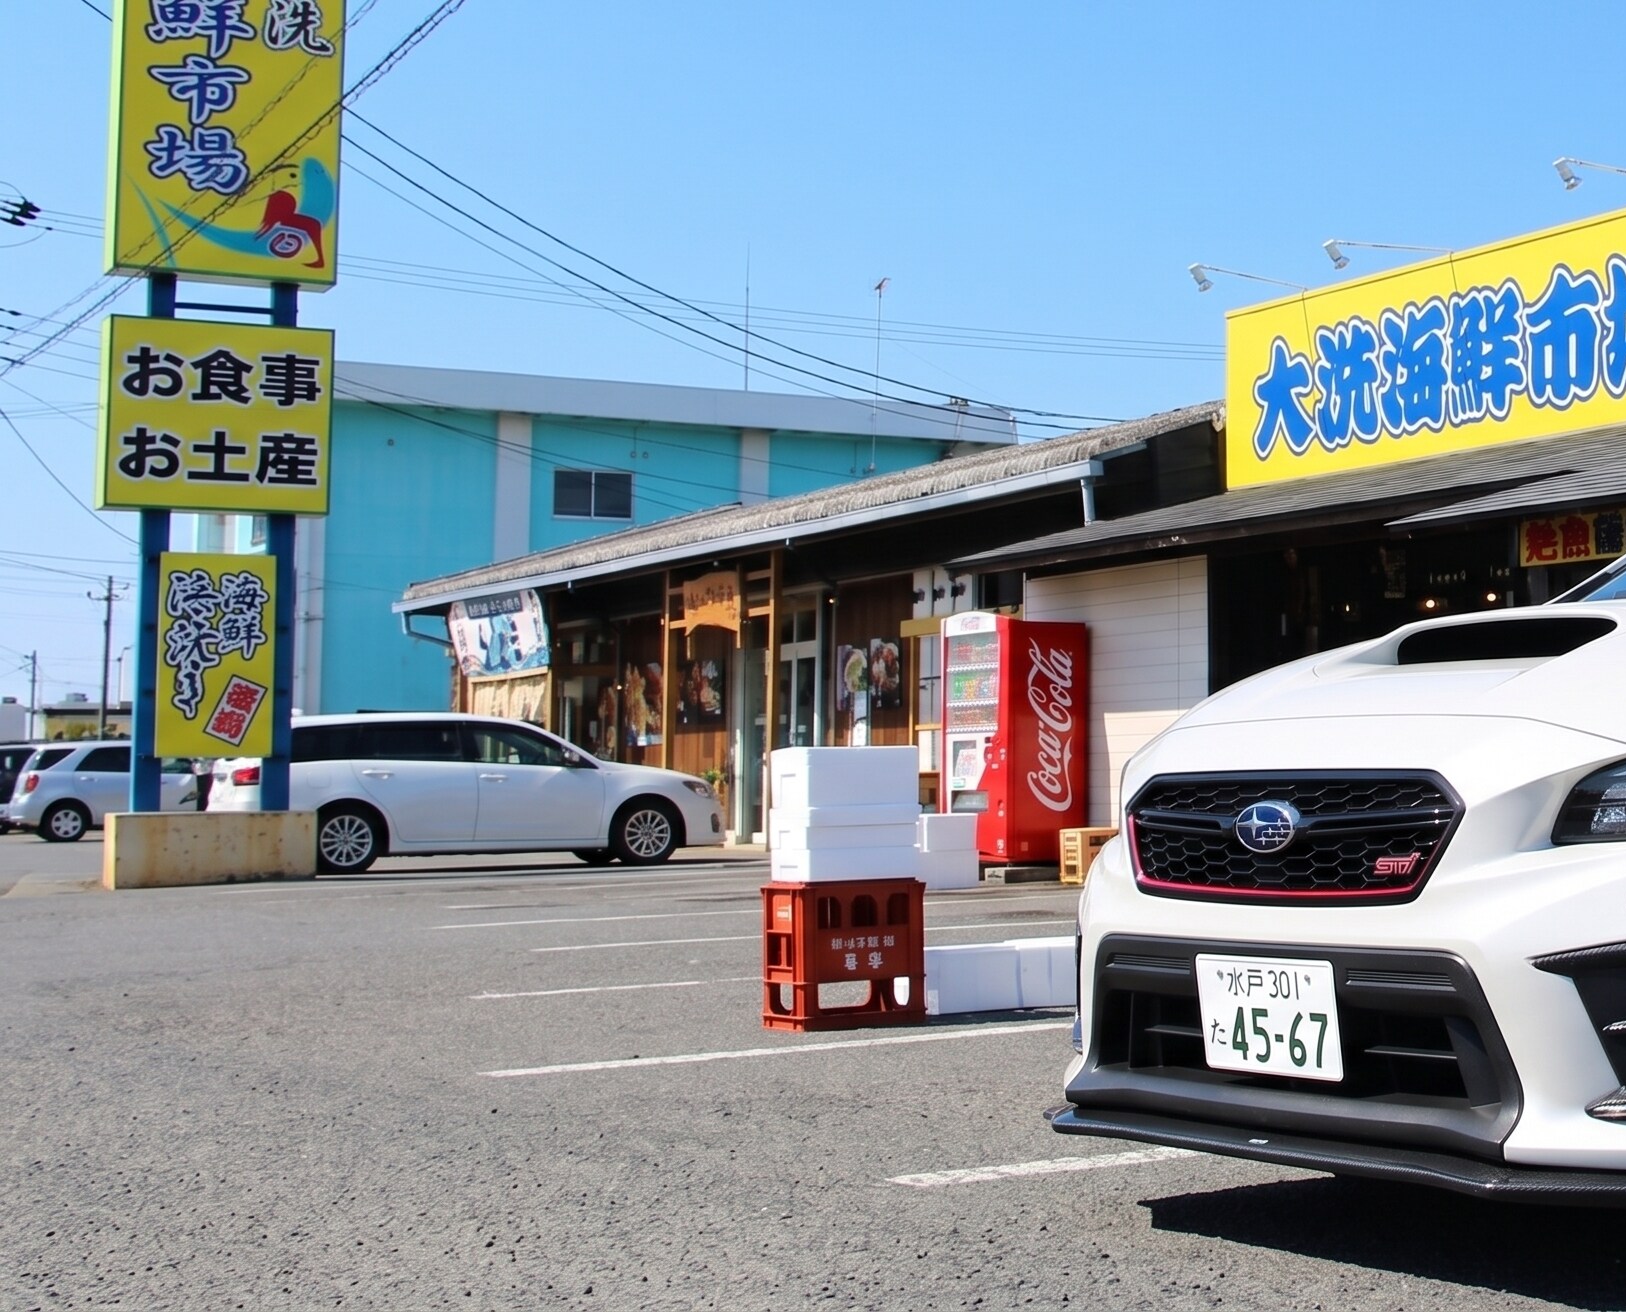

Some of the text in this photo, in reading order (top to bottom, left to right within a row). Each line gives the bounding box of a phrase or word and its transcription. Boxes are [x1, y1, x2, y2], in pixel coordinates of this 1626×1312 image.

[122, 346, 322, 407] お食事
[118, 426, 319, 487] お土産
[219, 573, 269, 660] 海鮮
[1027, 637, 1073, 812] Coca-Cola
[1211, 1006, 1328, 1069] た 45-67
